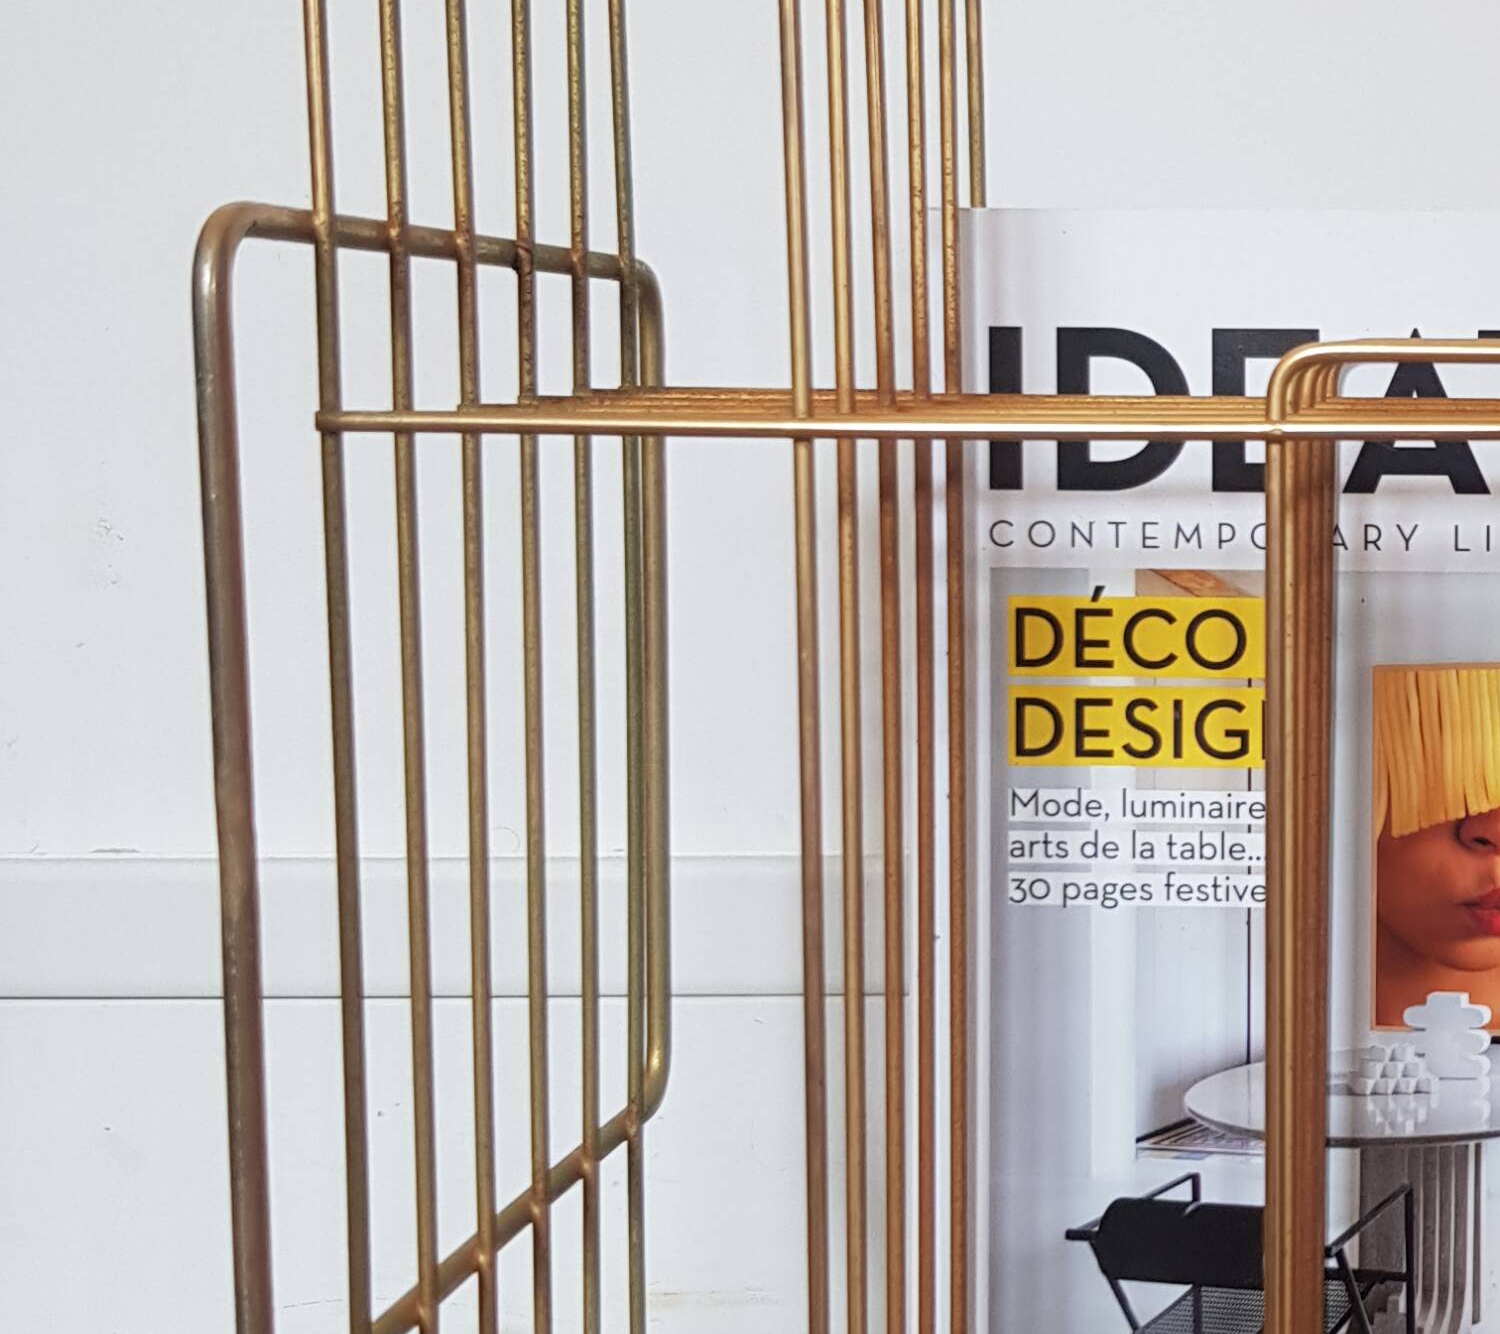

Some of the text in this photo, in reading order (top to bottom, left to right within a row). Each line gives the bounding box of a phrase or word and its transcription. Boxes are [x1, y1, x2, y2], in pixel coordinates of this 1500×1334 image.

[990, 520, 1418, 552] CONTEMPOARY
[1015, 585, 1248, 671] DÉCO
[1015, 697, 1266, 760] DESIG
[1011, 787, 1266, 821] Mode, luminaire
[1009, 832, 1069, 859] arts
[1080, 829, 1119, 859] de
[1132, 829, 1155, 860] la
[1009, 871, 1267, 909] 30 pages festive
